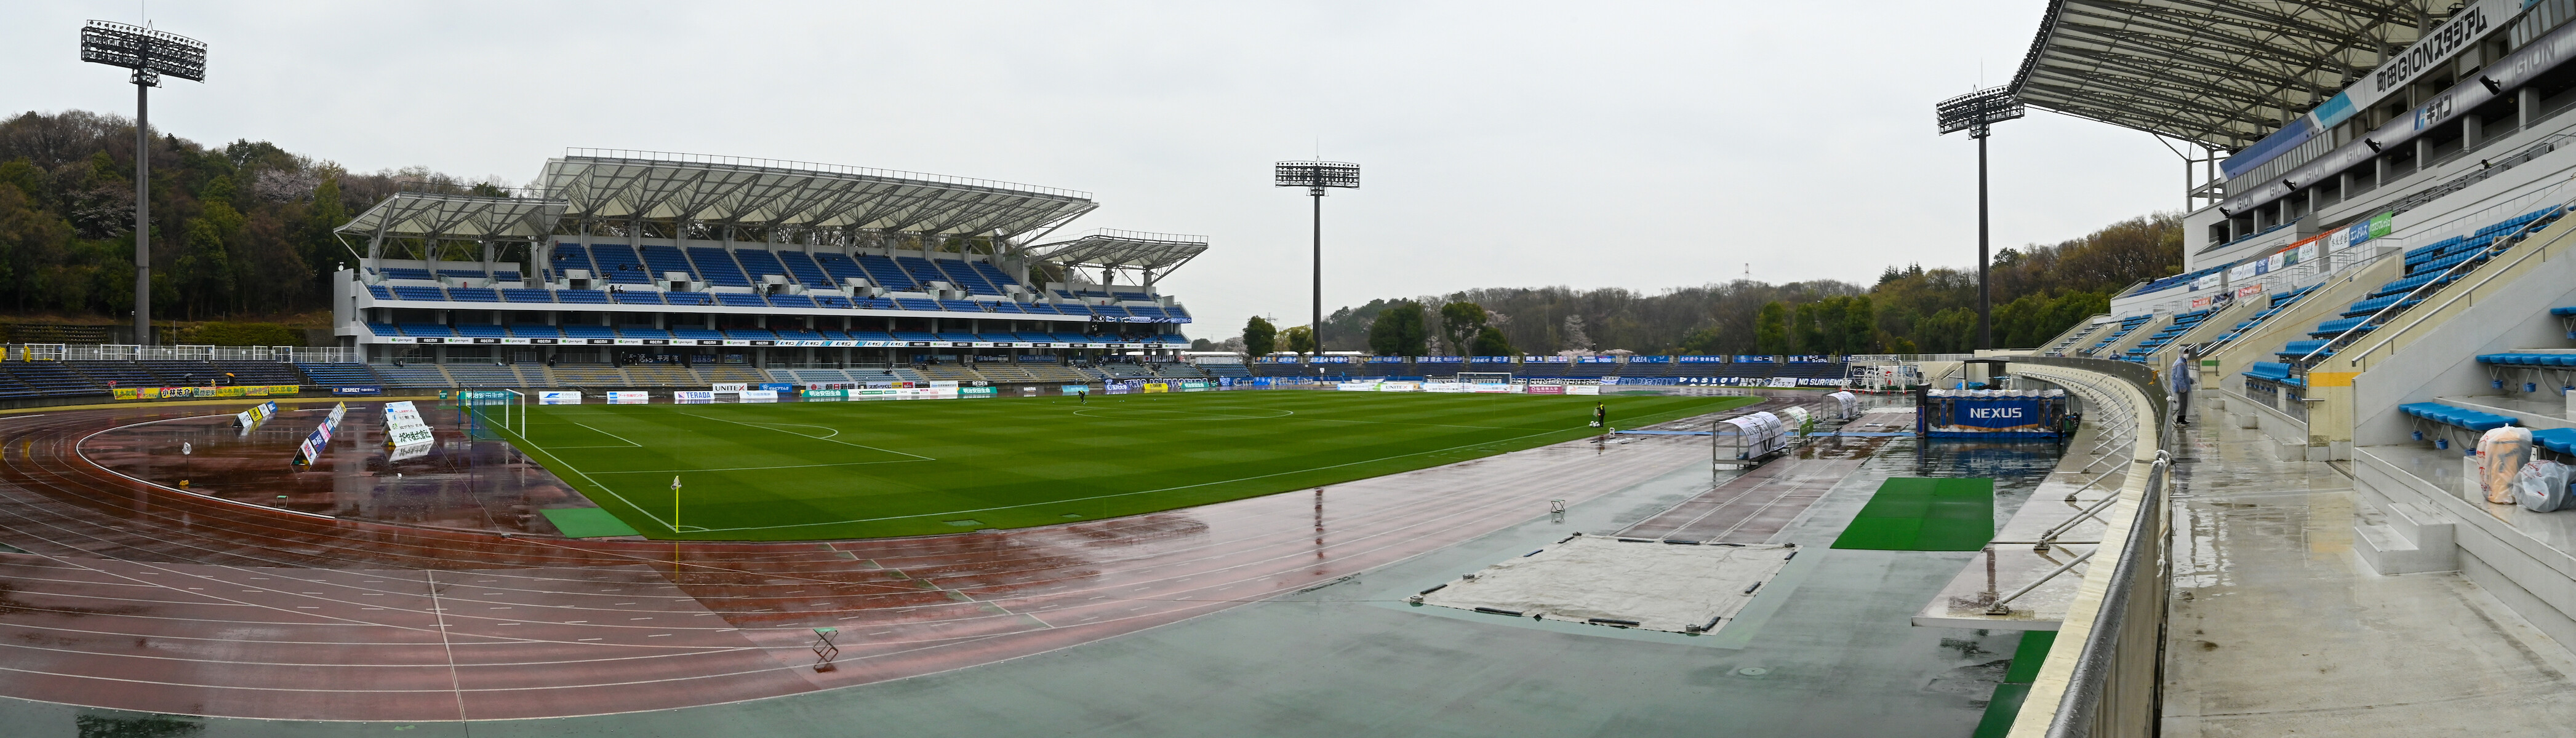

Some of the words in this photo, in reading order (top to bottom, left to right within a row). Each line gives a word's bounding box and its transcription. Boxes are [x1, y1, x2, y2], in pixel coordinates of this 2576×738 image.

[2377, 6, 2487, 92] 町田GIONスタジアム
[2426, 94, 2451, 125] ギオン
[2306, 163, 2326, 182] GION
[2237, 193, 2254, 210] GION
[2350, 225, 2368, 240] エンドレス
[162, 388, 190, 397] 小林祐介
[1970, 407, 2022, 419] NEXUS
